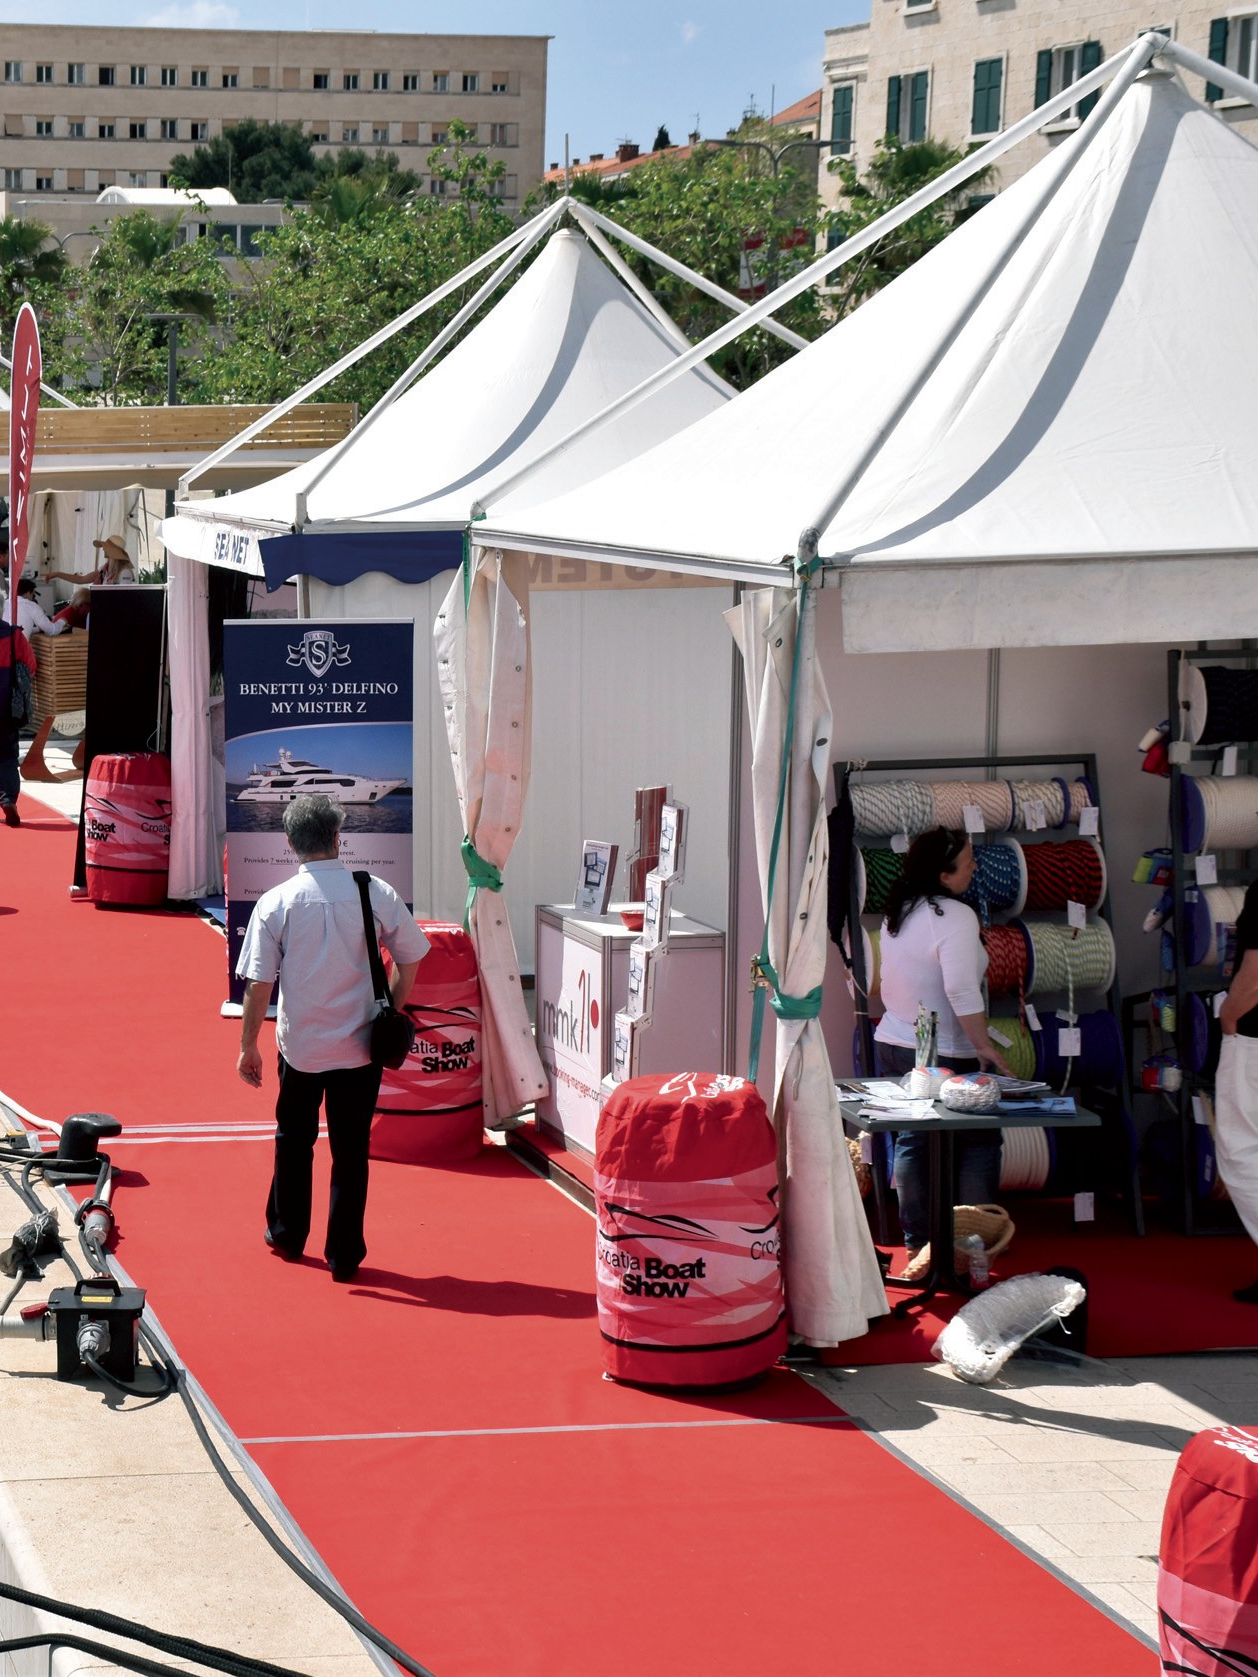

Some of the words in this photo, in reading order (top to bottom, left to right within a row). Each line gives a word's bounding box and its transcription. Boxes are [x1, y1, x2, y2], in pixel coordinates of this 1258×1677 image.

[214, 532, 230, 561] SEA
[231, 534, 249, 565] NET
[311, 641, 326, 665] S
[239, 683, 304, 695] BENETTI
[332, 683, 398, 695] DELFINO
[271, 702, 295, 714] MY
[297, 702, 353, 714] MISTER
[356, 702, 367, 713] Z
[442, 1036, 475, 1058] Boat
[422, 1056, 468, 1073] Show
[644, 1257, 706, 1279] Boat
[622, 1273, 690, 1298] Show
